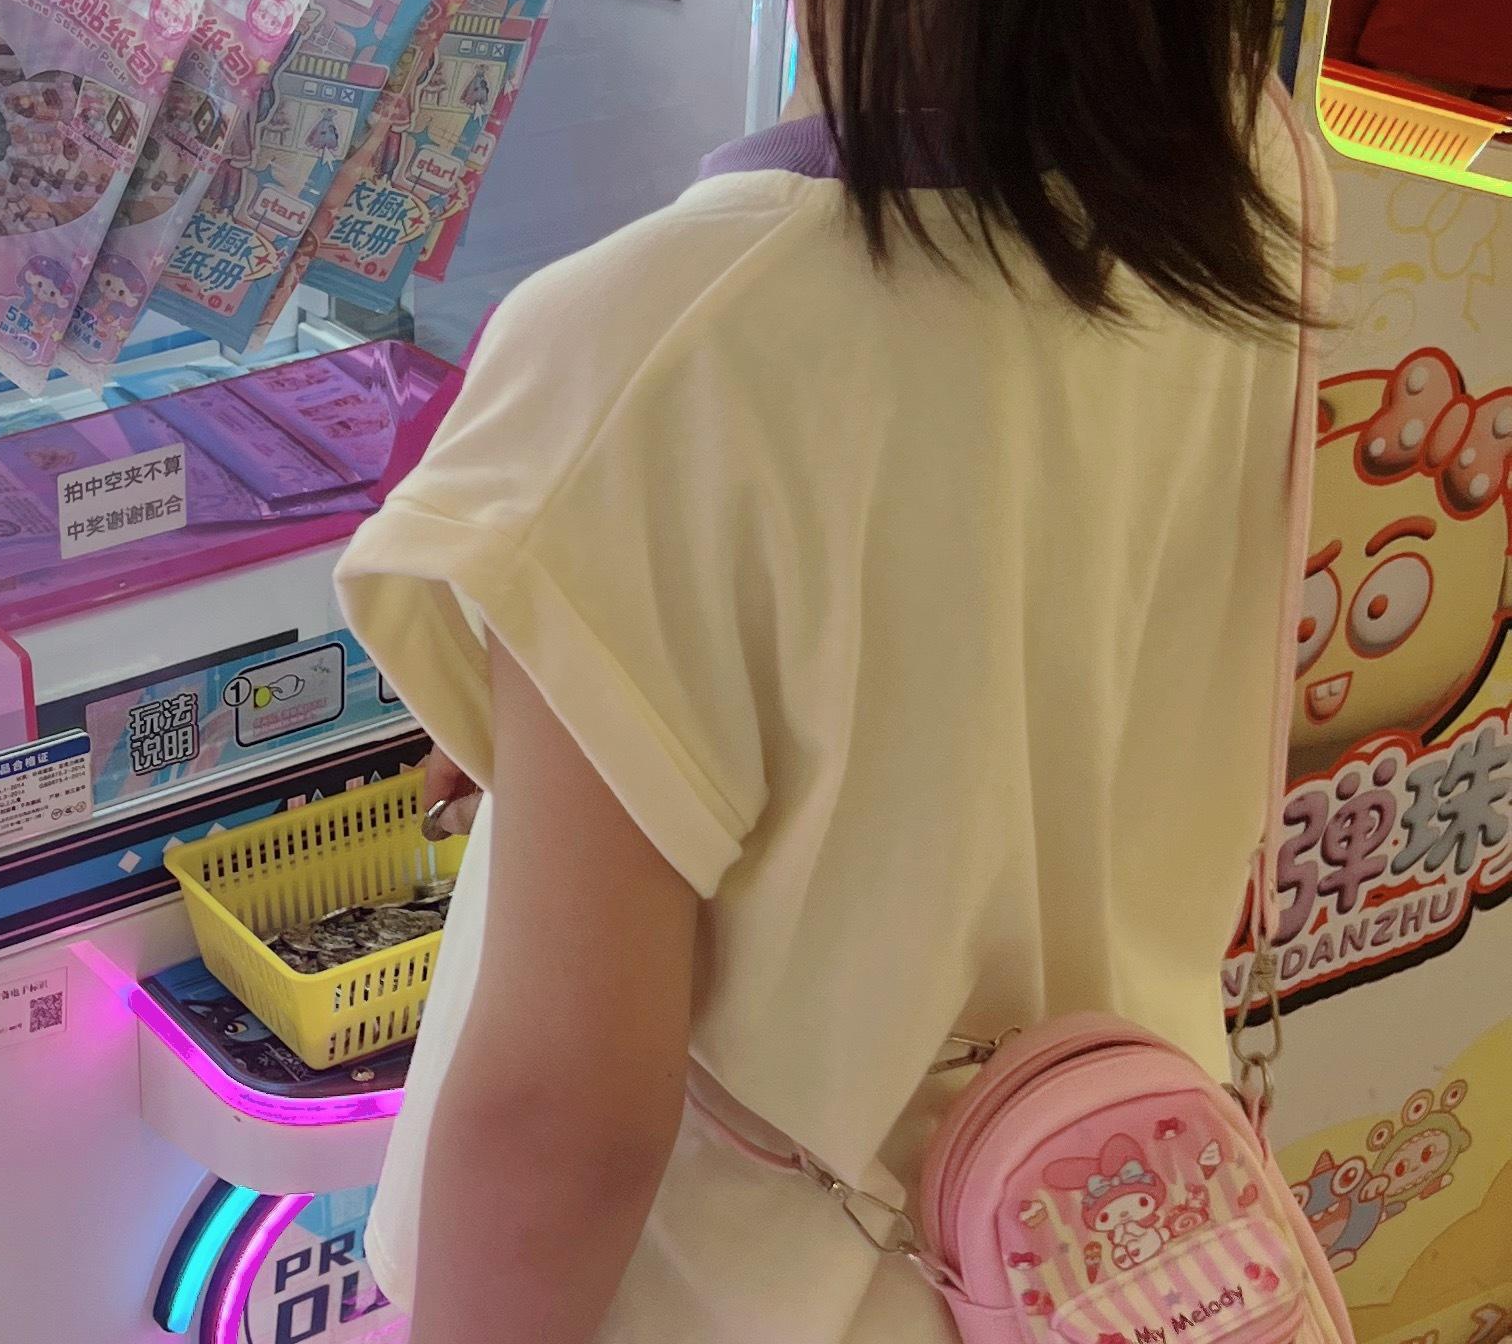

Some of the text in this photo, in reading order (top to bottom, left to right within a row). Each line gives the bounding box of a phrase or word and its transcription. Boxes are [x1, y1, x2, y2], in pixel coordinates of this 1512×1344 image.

[54, 14, 97, 51] Sticker
[100, 50, 129, 83] Pack
[416, 158, 457, 182] start
[259, 197, 306, 226] start
[63, 454, 183, 504] 拍中空夹不算
[66, 494, 184, 541] 中奖谢谢配合
[129, 693, 197, 740] 玩法
[131, 725, 199, 775] 说明
[274, 1230, 366, 1294] PR
[1170, 1284, 1246, 1335] Melody
